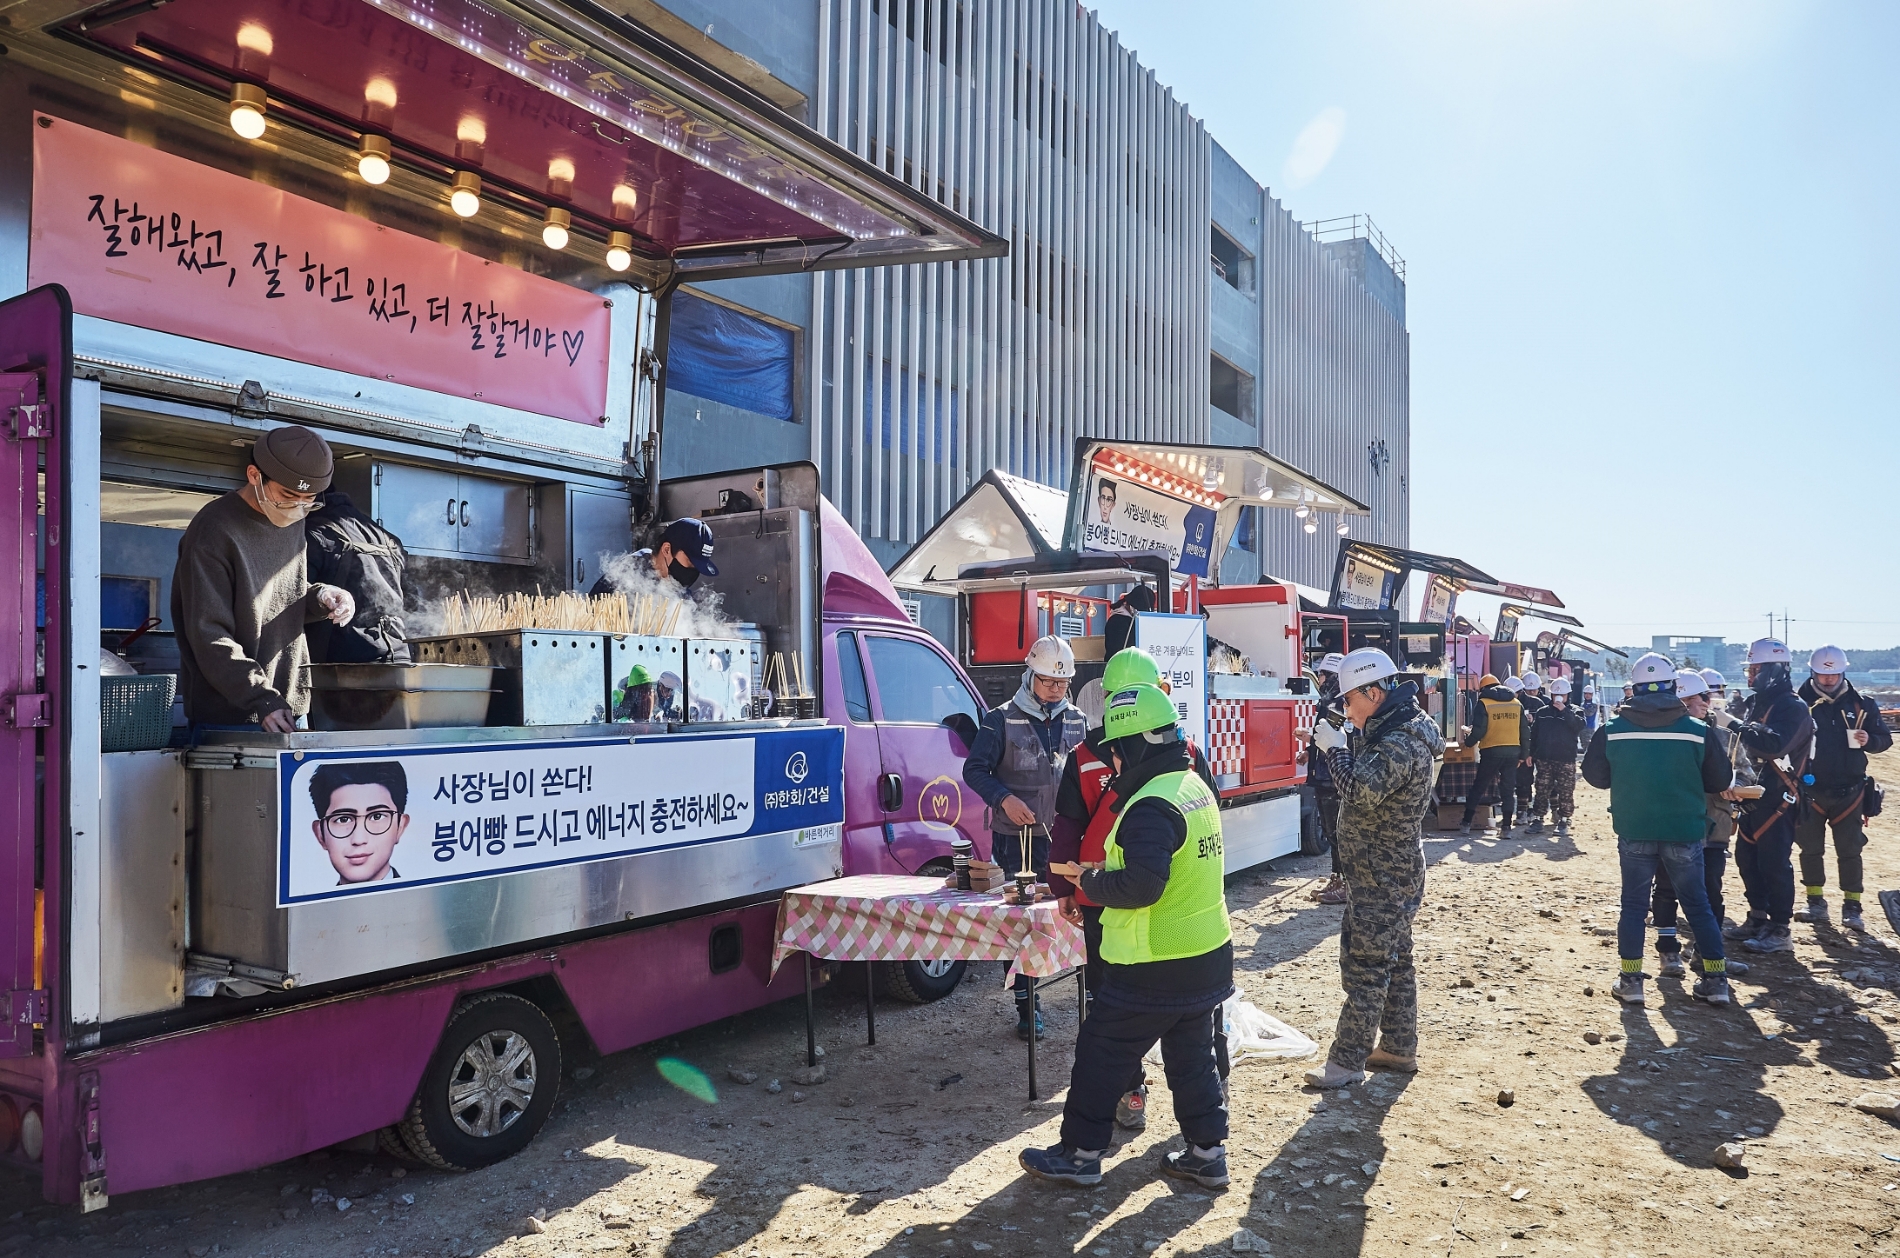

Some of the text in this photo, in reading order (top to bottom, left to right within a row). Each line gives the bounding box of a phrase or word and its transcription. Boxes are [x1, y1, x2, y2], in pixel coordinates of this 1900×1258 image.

[87, 194, 237, 288] 잘해왔고,
[252, 241, 288, 299] 잘
[298, 251, 354, 303] 하고
[366, 277, 417, 334] 있고,
[426, 296, 450, 327] 더
[297, 480, 310, 491] LA
[1124, 501, 1153, 526] 사장님이
[1086, 522, 1110, 545] 붕어빵
[1110, 530, 1128, 549] 드시고
[1128, 532, 1149, 552] 에너지
[1148, 644, 1195, 657] 추운 겨울날에도
[434, 765, 592, 805] 사장님이 쏜다!
[432, 792, 750, 863] 붕어빵 드시고 에너지 충전하세요~
[805, 826, 835, 841] 바른먹거리
